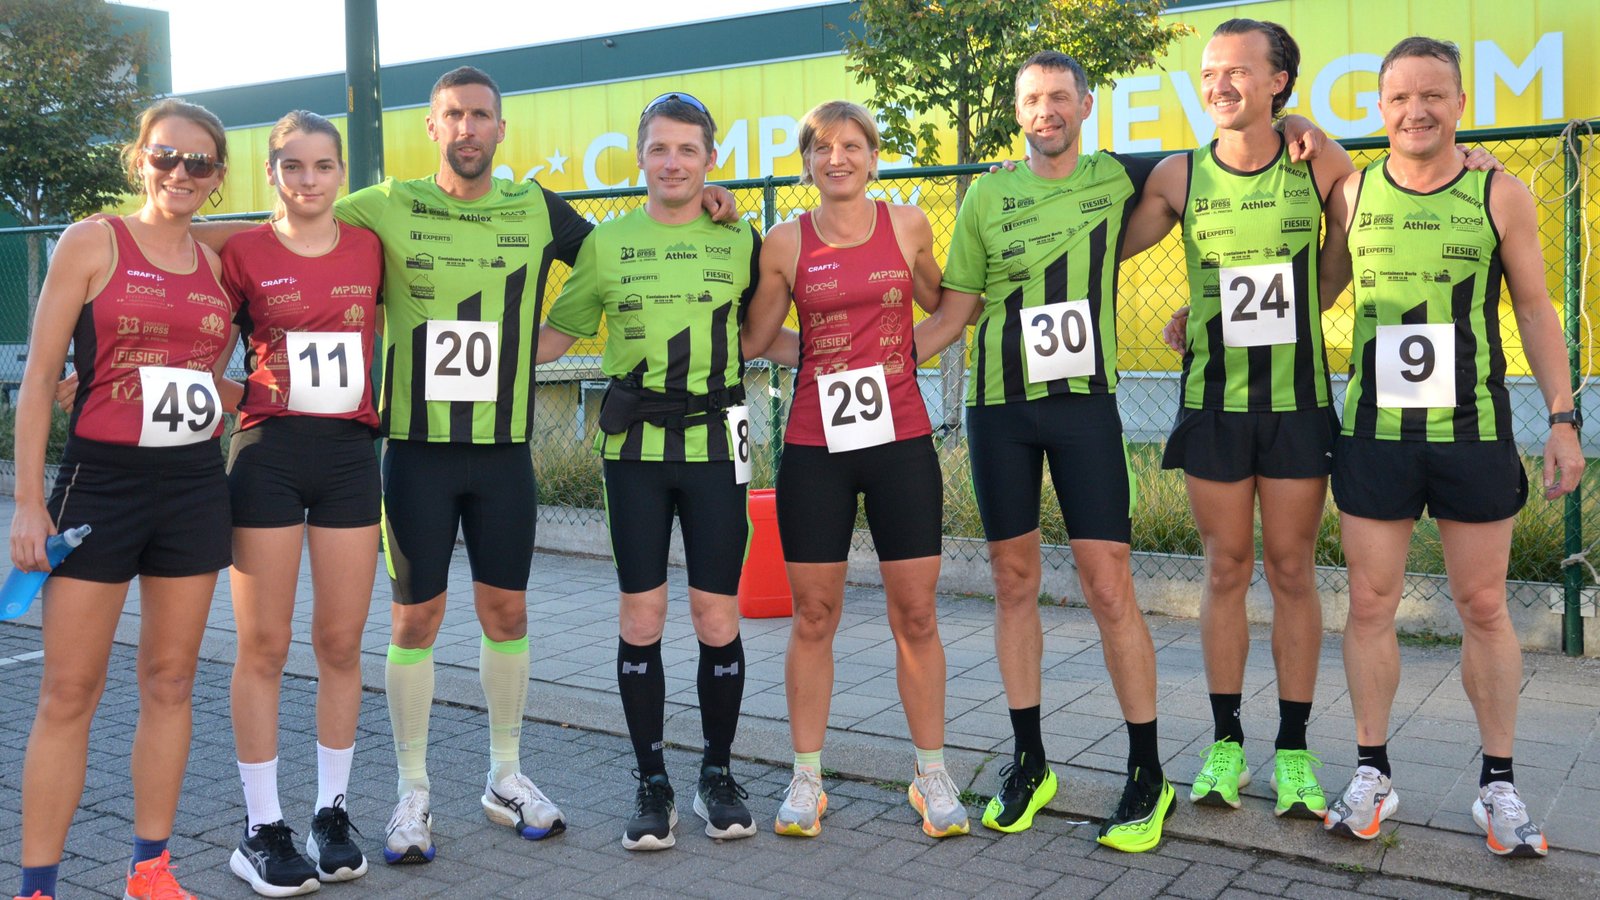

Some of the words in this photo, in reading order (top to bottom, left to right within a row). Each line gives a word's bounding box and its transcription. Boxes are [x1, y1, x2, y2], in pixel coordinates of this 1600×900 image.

[1082, 197, 1109, 210] FIESIEK
[1450, 188, 1483, 210] BIORACER
[1241, 200, 1276, 211] Athlex
[459, 213, 492, 223] Athlex
[1284, 220, 1311, 229] FIESIEK
[1403, 221, 1440, 231] Athlex
[423, 234, 451, 242] EXPERTS
[1207, 229, 1234, 238] EXPERTS
[500, 236, 527, 244] FIESIEK
[1366, 246, 1393, 254] EXPERTS
[1446, 246, 1479, 257] FIESIEK
[665, 252, 698, 260] Athlex
[808, 264, 832, 273] CRAFT
[127, 269, 156, 280] CRAFT
[706, 270, 731, 280] FIESIEK
[261, 278, 288, 288] CRAFT
[331, 285, 372, 295] MPOWR
[1229, 273, 1289, 322] 24
[143, 325, 169, 335] press
[1031, 309, 1087, 357] 30
[815, 337, 848, 349] FIESIEK
[880, 335, 903, 347] MKH
[118, 351, 164, 363] FIESIEK
[434, 331, 492, 377] 20
[1400, 335, 1435, 382] 9
[299, 342, 348, 388] 11
[152, 382, 216, 432] 49
[827, 376, 883, 427] 29
